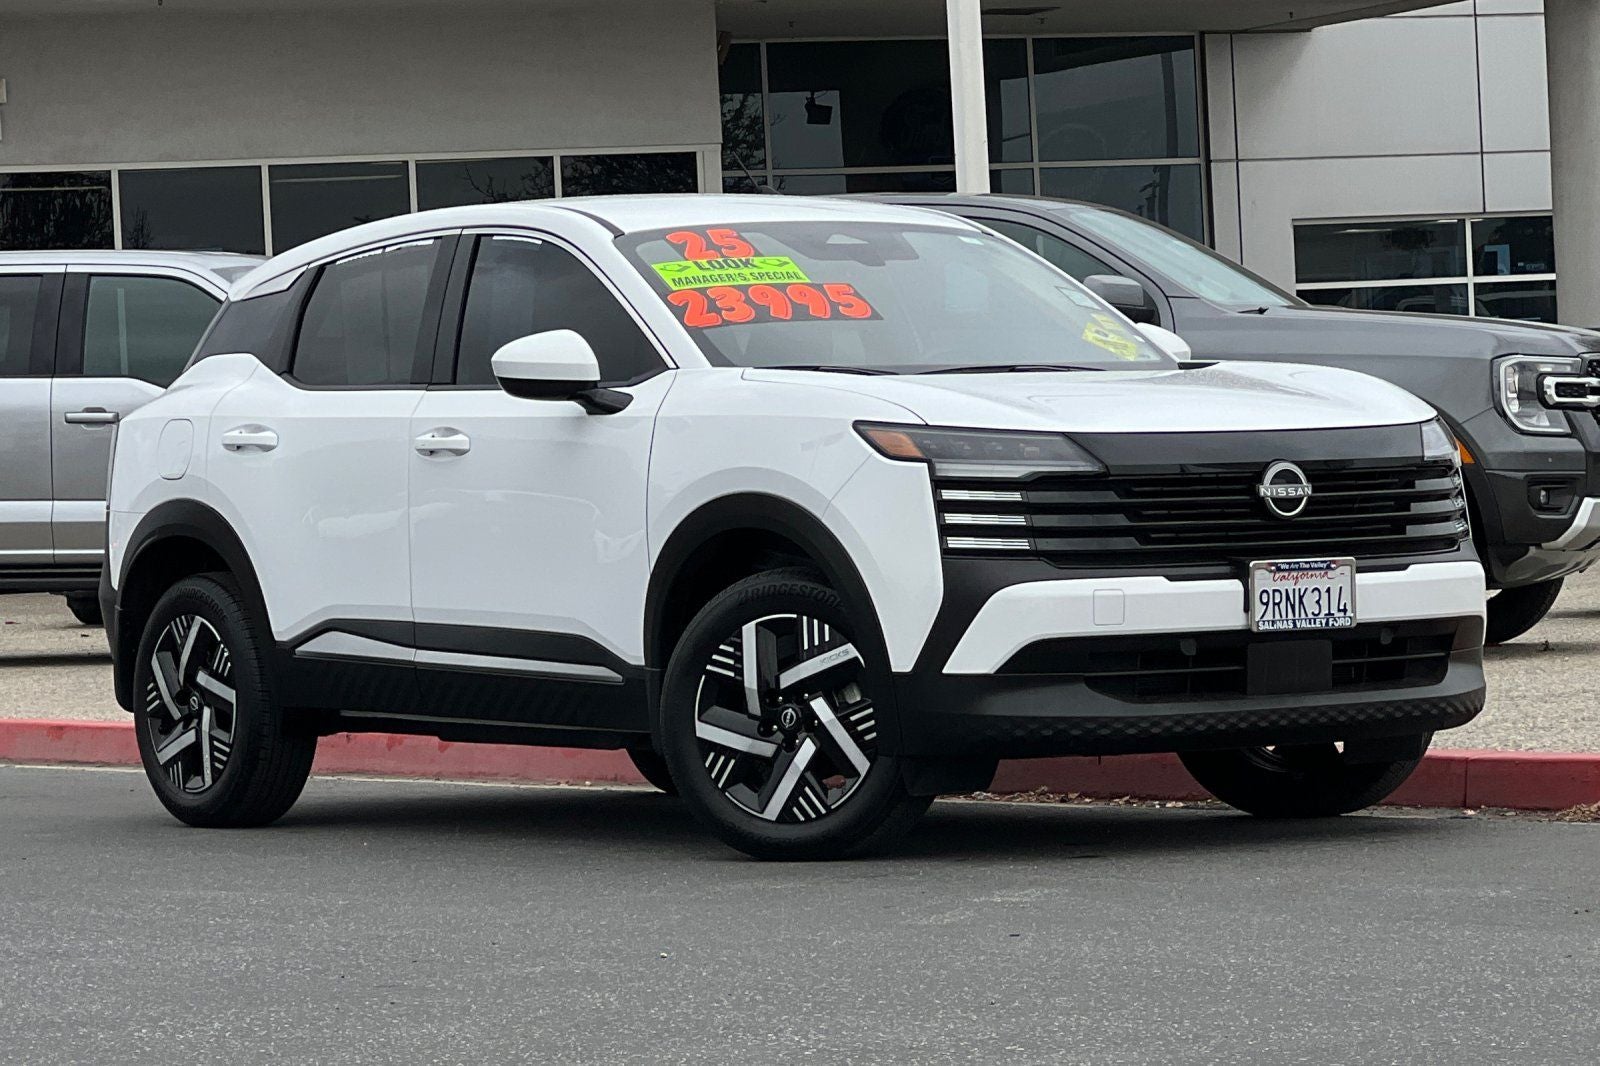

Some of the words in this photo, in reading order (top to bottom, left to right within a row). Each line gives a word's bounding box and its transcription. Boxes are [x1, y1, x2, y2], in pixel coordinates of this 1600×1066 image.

[666, 228, 755, 261] 25
[692, 257, 756, 271] LOOK
[671, 272, 747, 287] MANAGER'S
[749, 270, 802, 282] SPECIAL
[667, 283, 872, 327] 23995
[1259, 485, 1312, 497] NISSAN
[1272, 571, 1334, 586] California
[1258, 586, 1349, 619] 9RNK314
[1258, 620, 1294, 631] SALINAS
[1296, 618, 1327, 629] VALLEY
[1328, 617, 1352, 627] FORD
